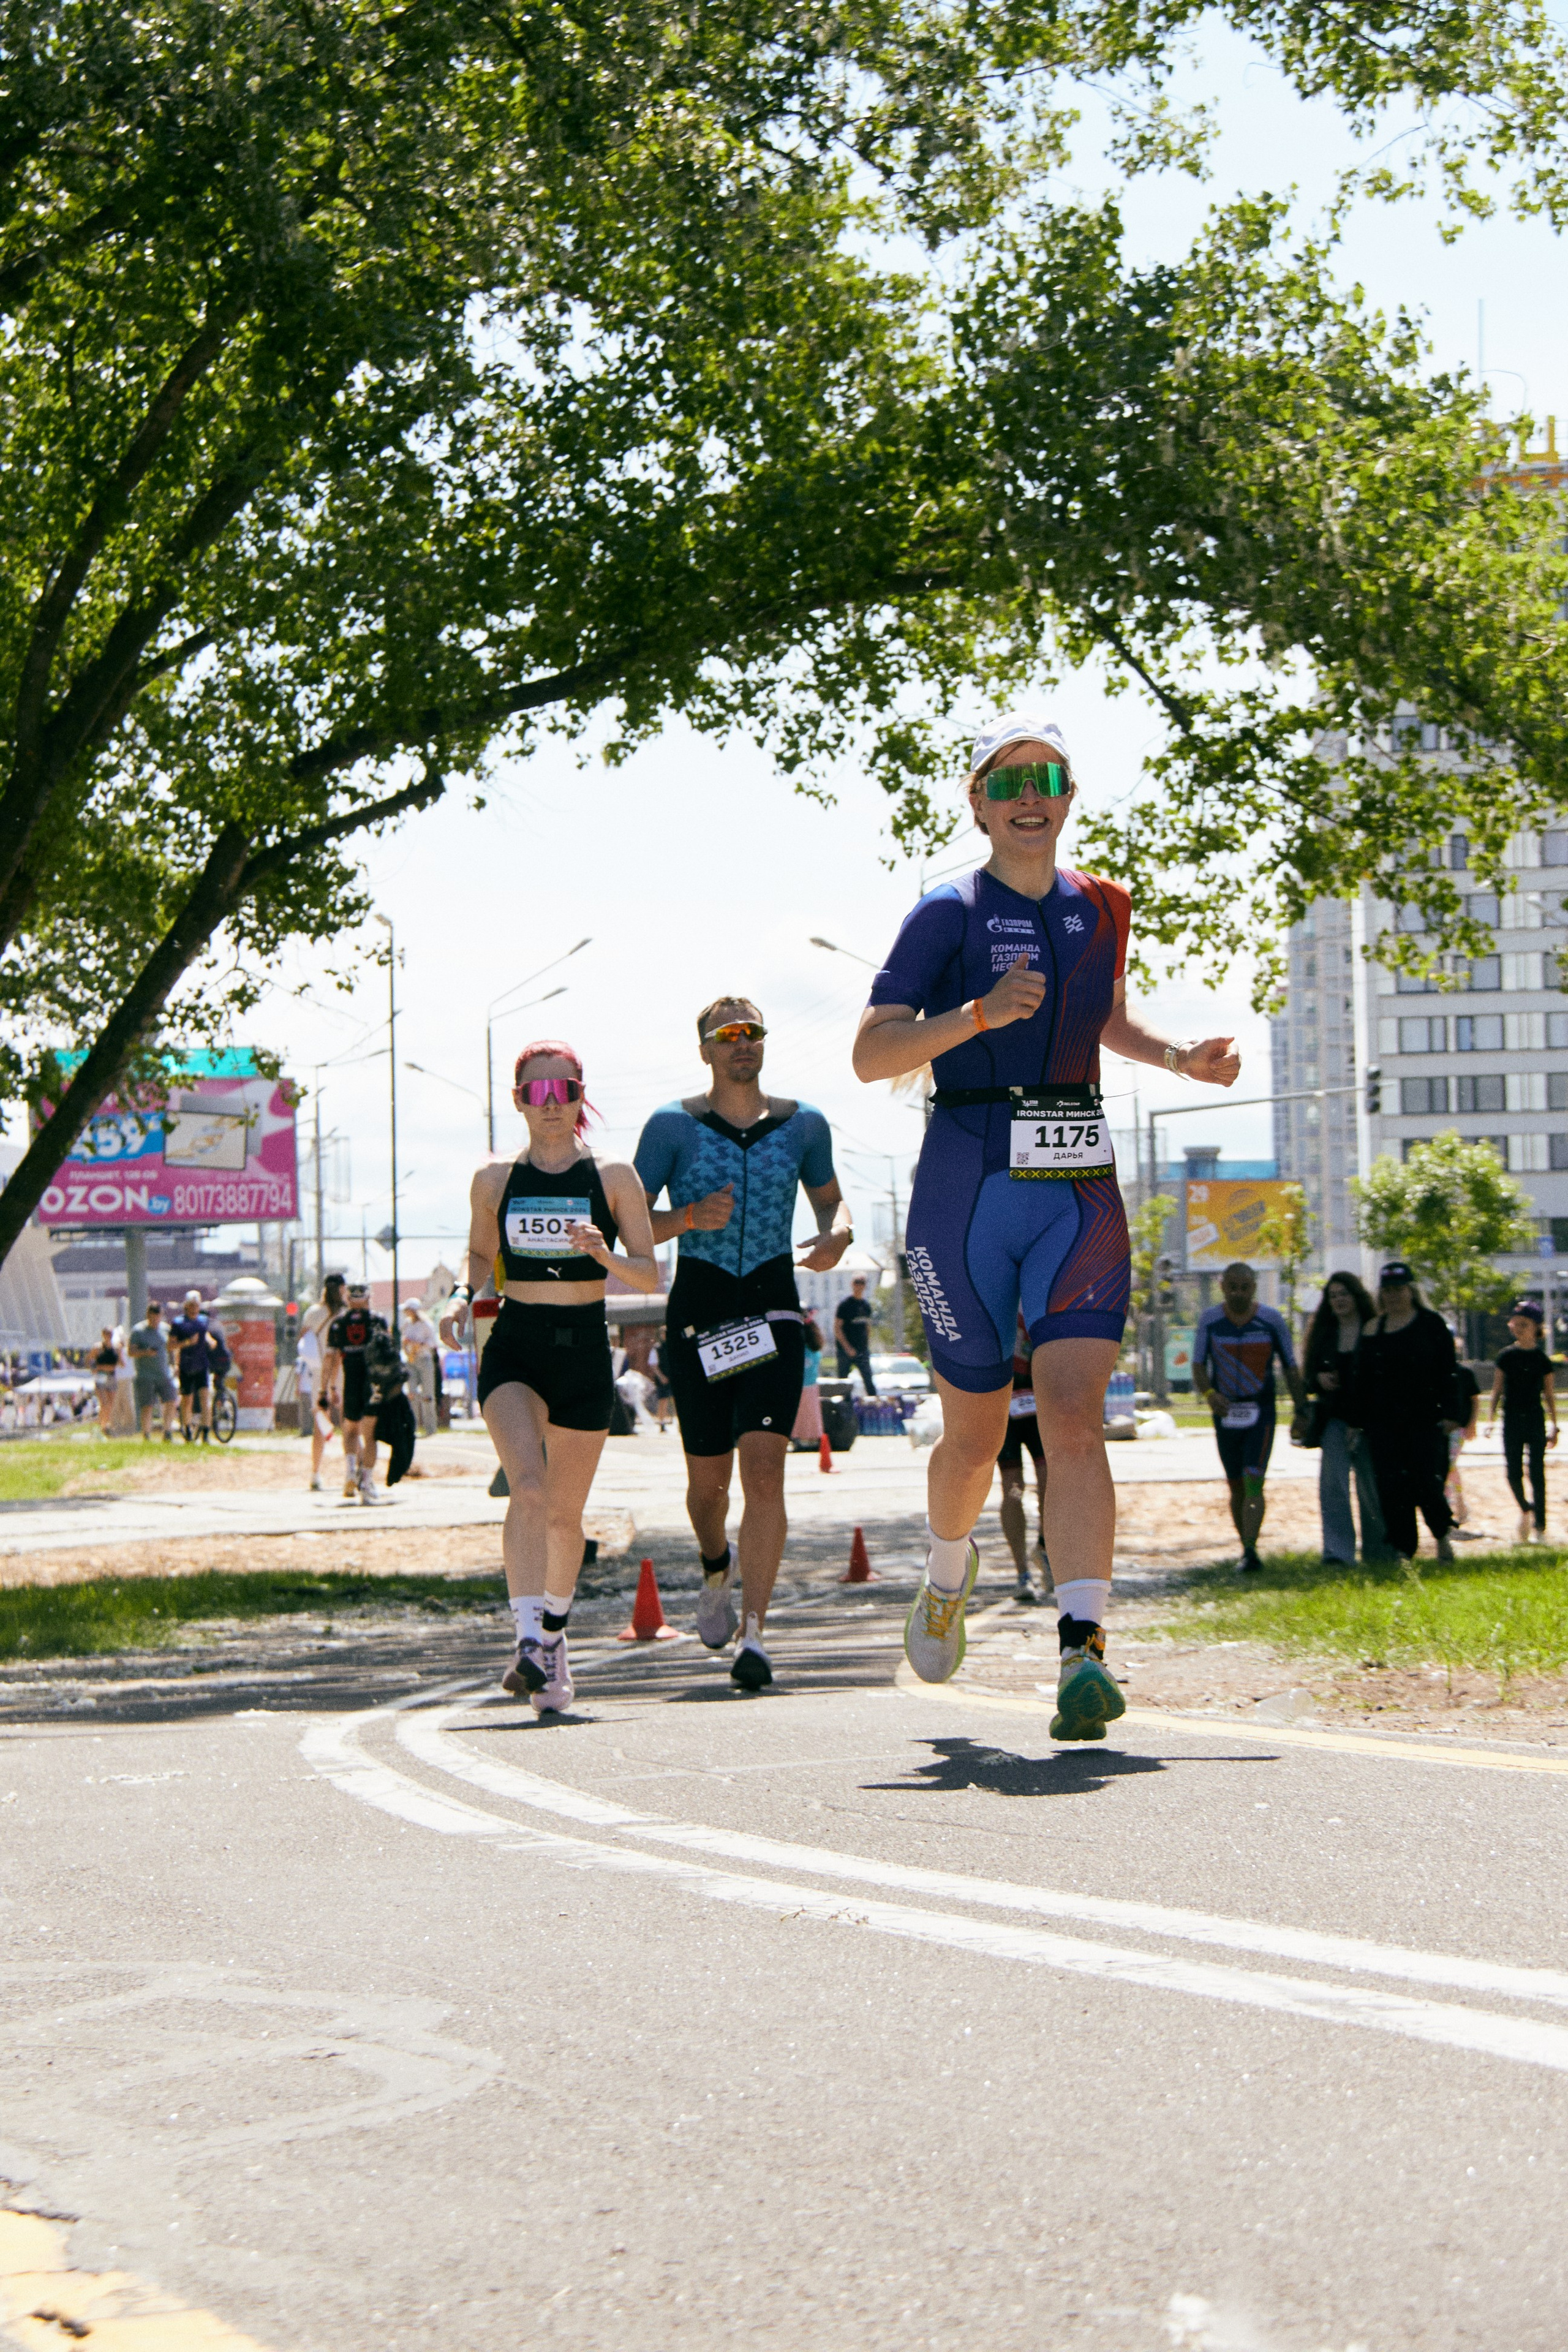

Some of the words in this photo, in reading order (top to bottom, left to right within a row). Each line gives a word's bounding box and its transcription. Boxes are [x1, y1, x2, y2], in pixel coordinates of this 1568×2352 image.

[1001, 919, 1033, 927] ГАЗПРОМ
[990, 944, 1041, 954] КОМАНДА
[1035, 1124, 1099, 1148] 1175
[173, 1183, 292, 1215] 80173887794
[907, 1250, 946, 1336] ГАЗПРОМ
[914, 1246, 962, 1341] КОМАНДА
[711, 1330, 760, 1360] 1325
